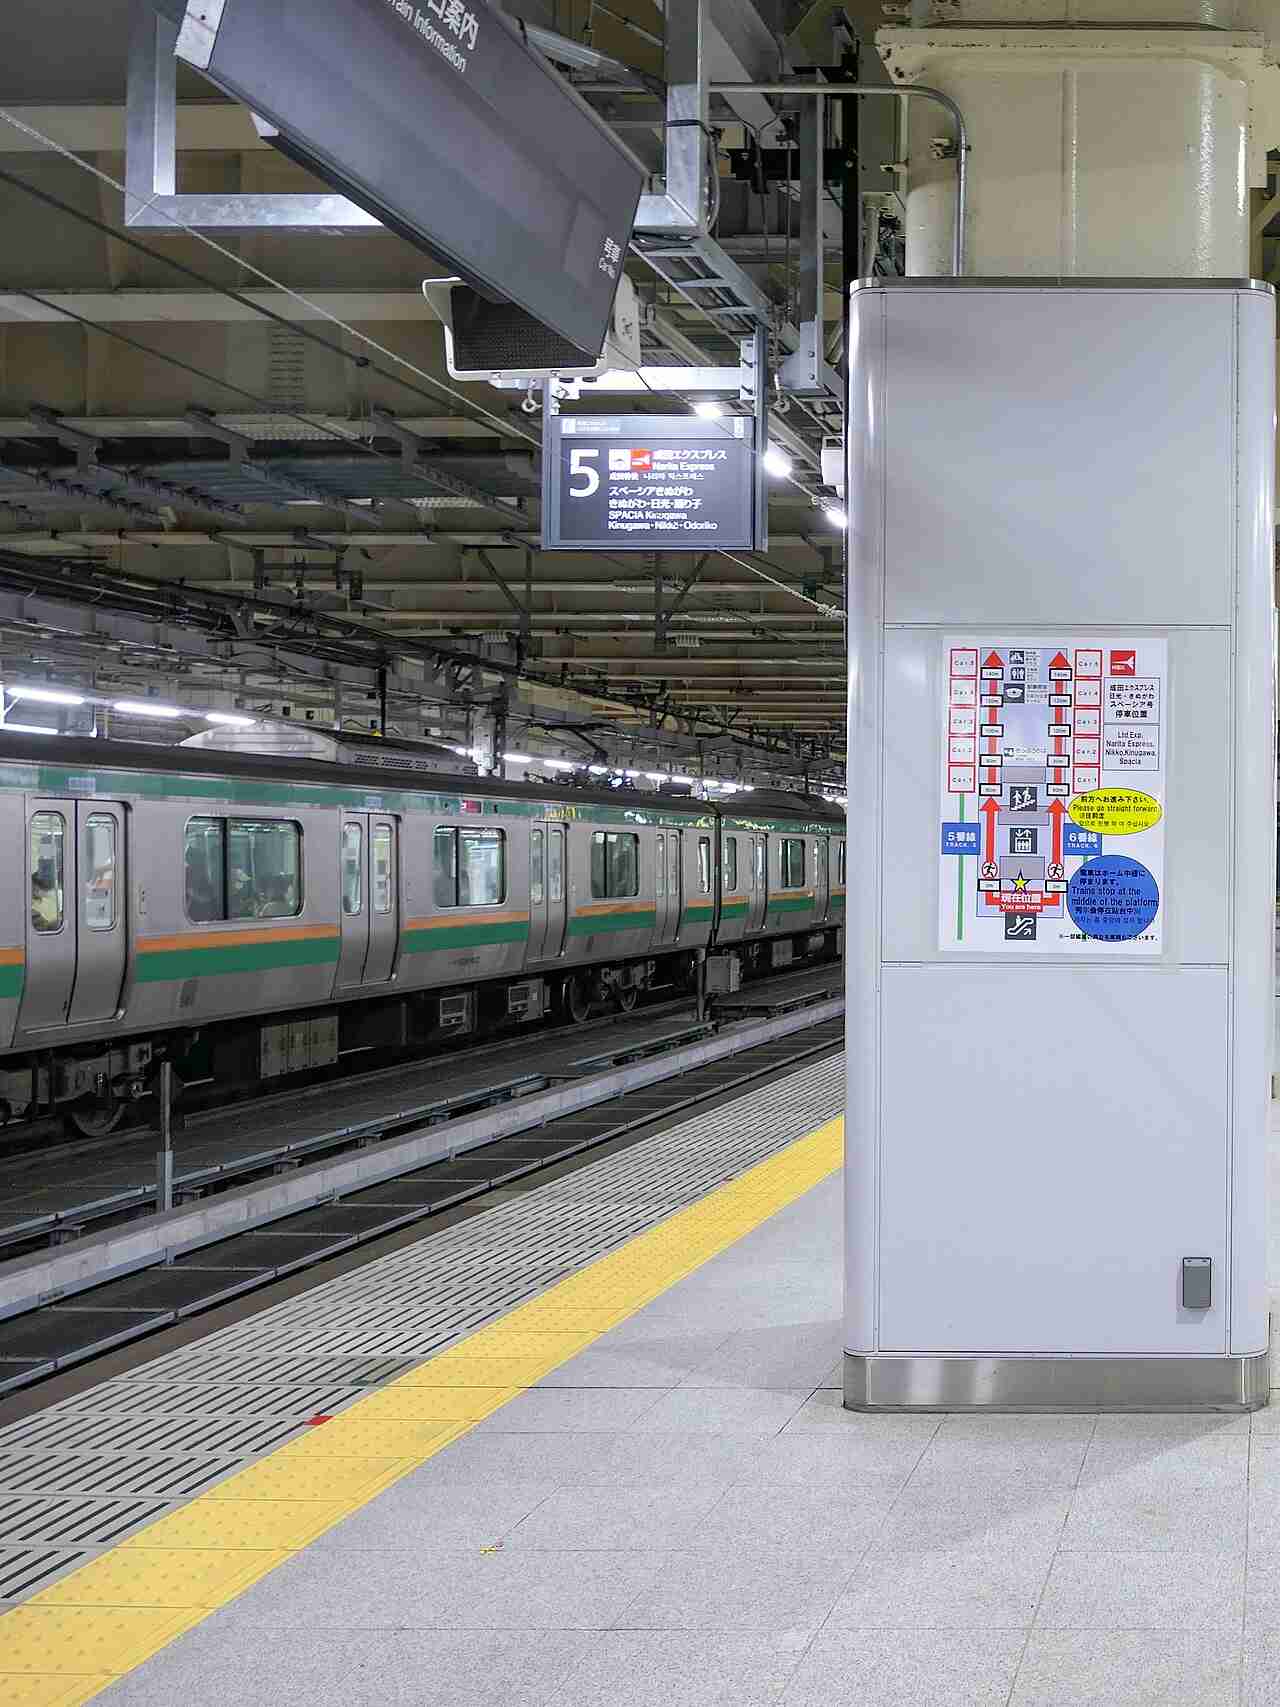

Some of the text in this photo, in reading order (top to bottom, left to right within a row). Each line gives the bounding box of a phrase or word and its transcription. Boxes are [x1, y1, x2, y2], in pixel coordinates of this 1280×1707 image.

[413, 9, 467, 72] Information
[569, 449, 600, 497] 5
[608, 510, 644, 520] SPACIA
[1107, 805, 1131, 813] straight
[947, 832, 977, 842] 5番線
[1069, 832, 1097, 842] 6番線
[1072, 886, 1096, 895] Trains
[1098, 886, 1115, 896] stop
[1128, 887, 1141, 895] the
[1072, 897, 1098, 905] middle
